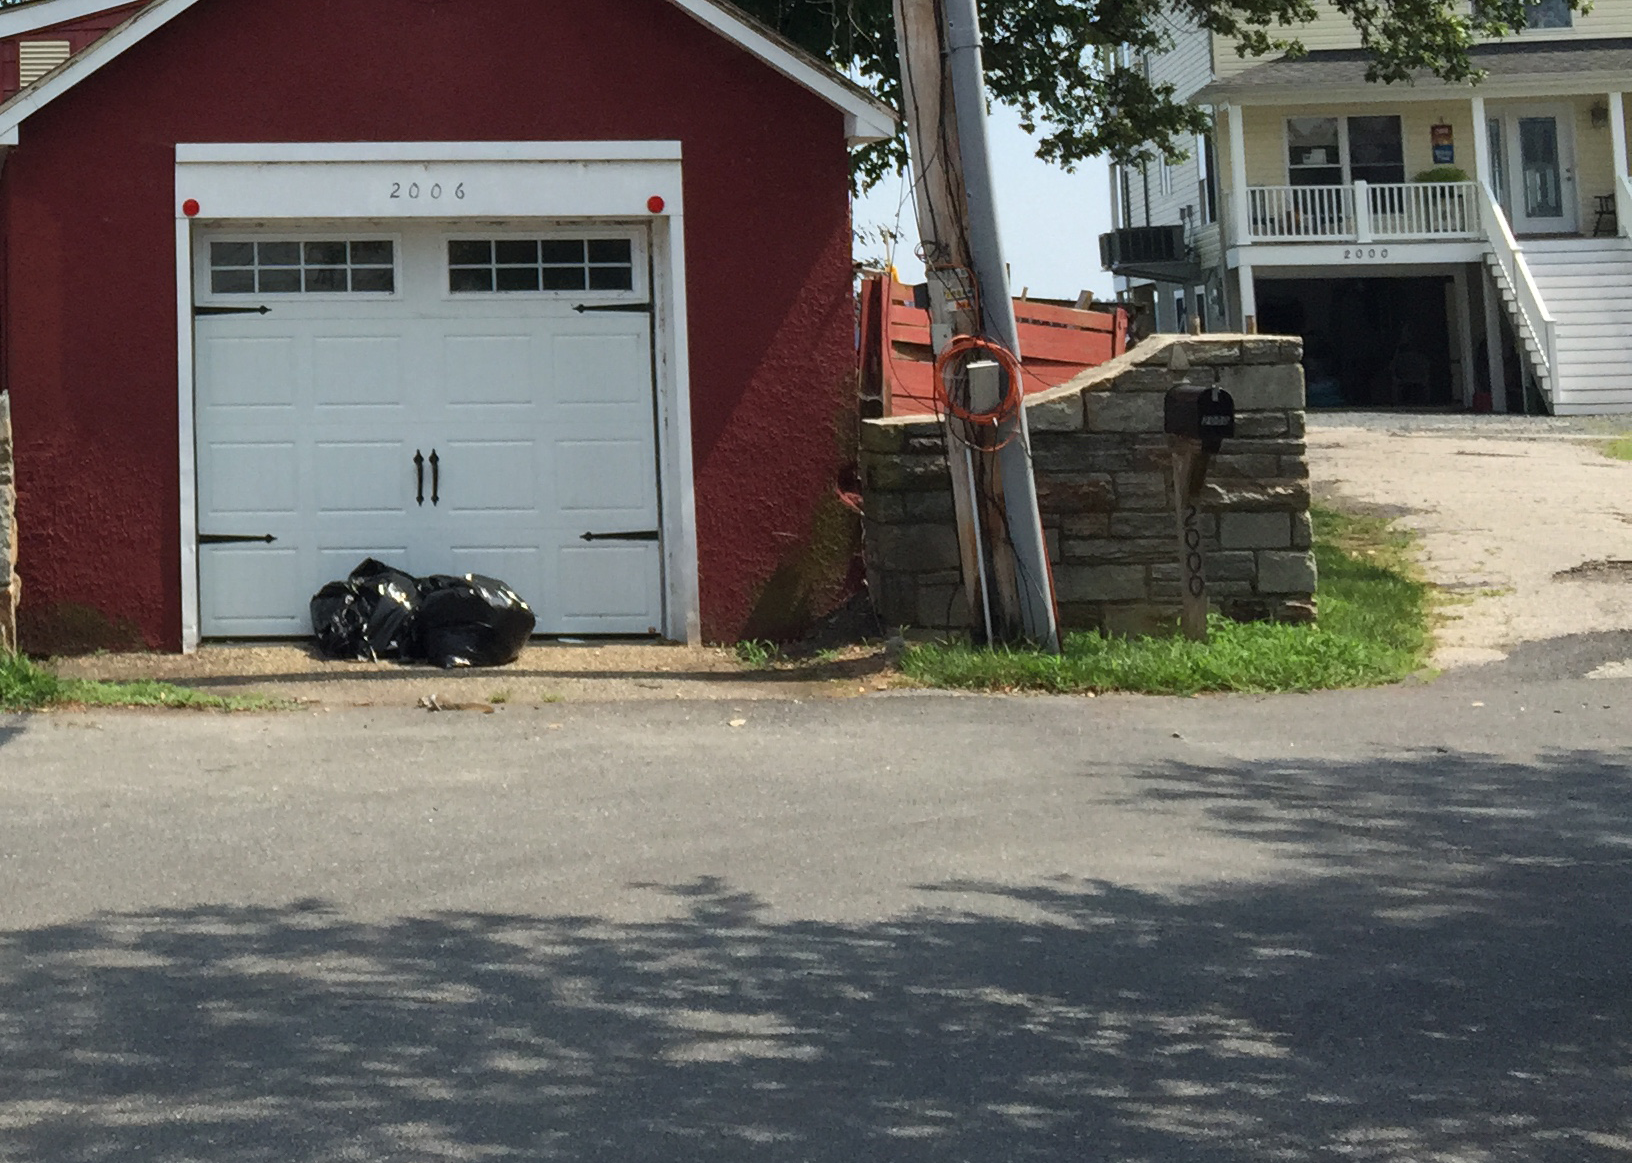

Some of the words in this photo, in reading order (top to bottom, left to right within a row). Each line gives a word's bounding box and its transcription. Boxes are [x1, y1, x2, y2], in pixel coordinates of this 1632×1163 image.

[389, 182, 466, 199] 2006
[1343, 248, 1389, 259] 2000
[1184, 503, 1205, 599] 2000
